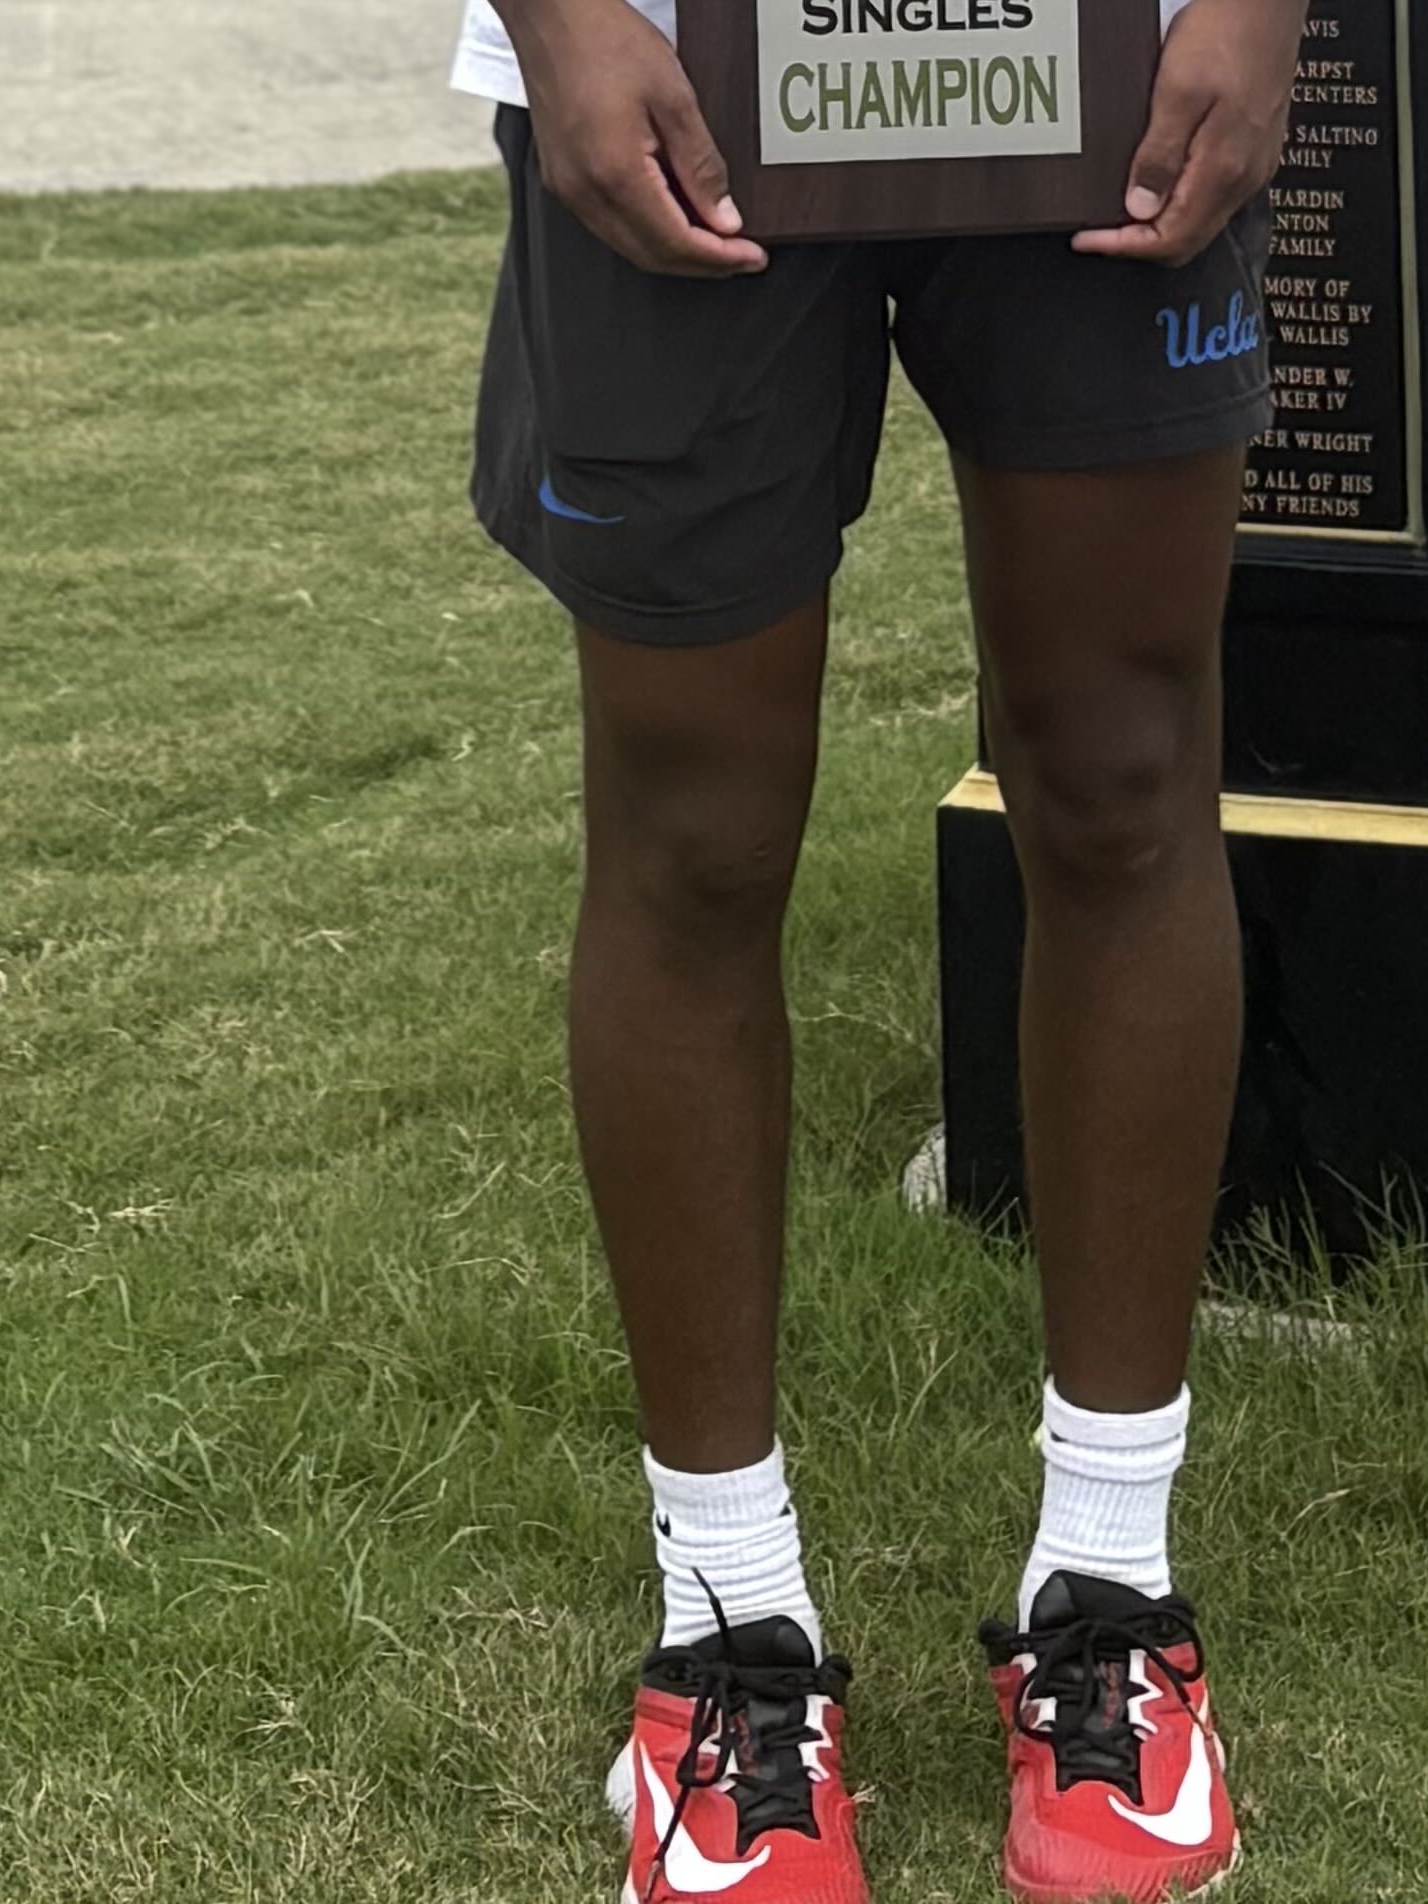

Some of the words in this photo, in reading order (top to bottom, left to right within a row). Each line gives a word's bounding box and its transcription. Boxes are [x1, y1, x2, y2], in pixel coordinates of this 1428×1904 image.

[779, 54, 1060, 133] CHAMPION
[1290, 85, 1378, 106] CENTERS
[1296, 125, 1378, 147] SALTINO
[1268, 188, 1345, 210] HARDIN
[1270, 213, 1330, 233] NTON
[1324, 278, 1351, 299] OF
[1270, 301, 1341, 324] WALLIS
[1348, 303, 1373, 325] BY
[1279, 324, 1350, 347] WALLIS
[1269, 365, 1327, 386] NDER
[1334, 367, 1355, 388] W.
[1326, 391, 1348, 411] IV
[1294, 431, 1374, 453] WRIGHT
[1264, 470, 1301, 491] ALL
[1308, 472, 1334, 493] OF
[1340, 474, 1374, 495] HIS
[1276, 494, 1361, 518] FRIENDS
